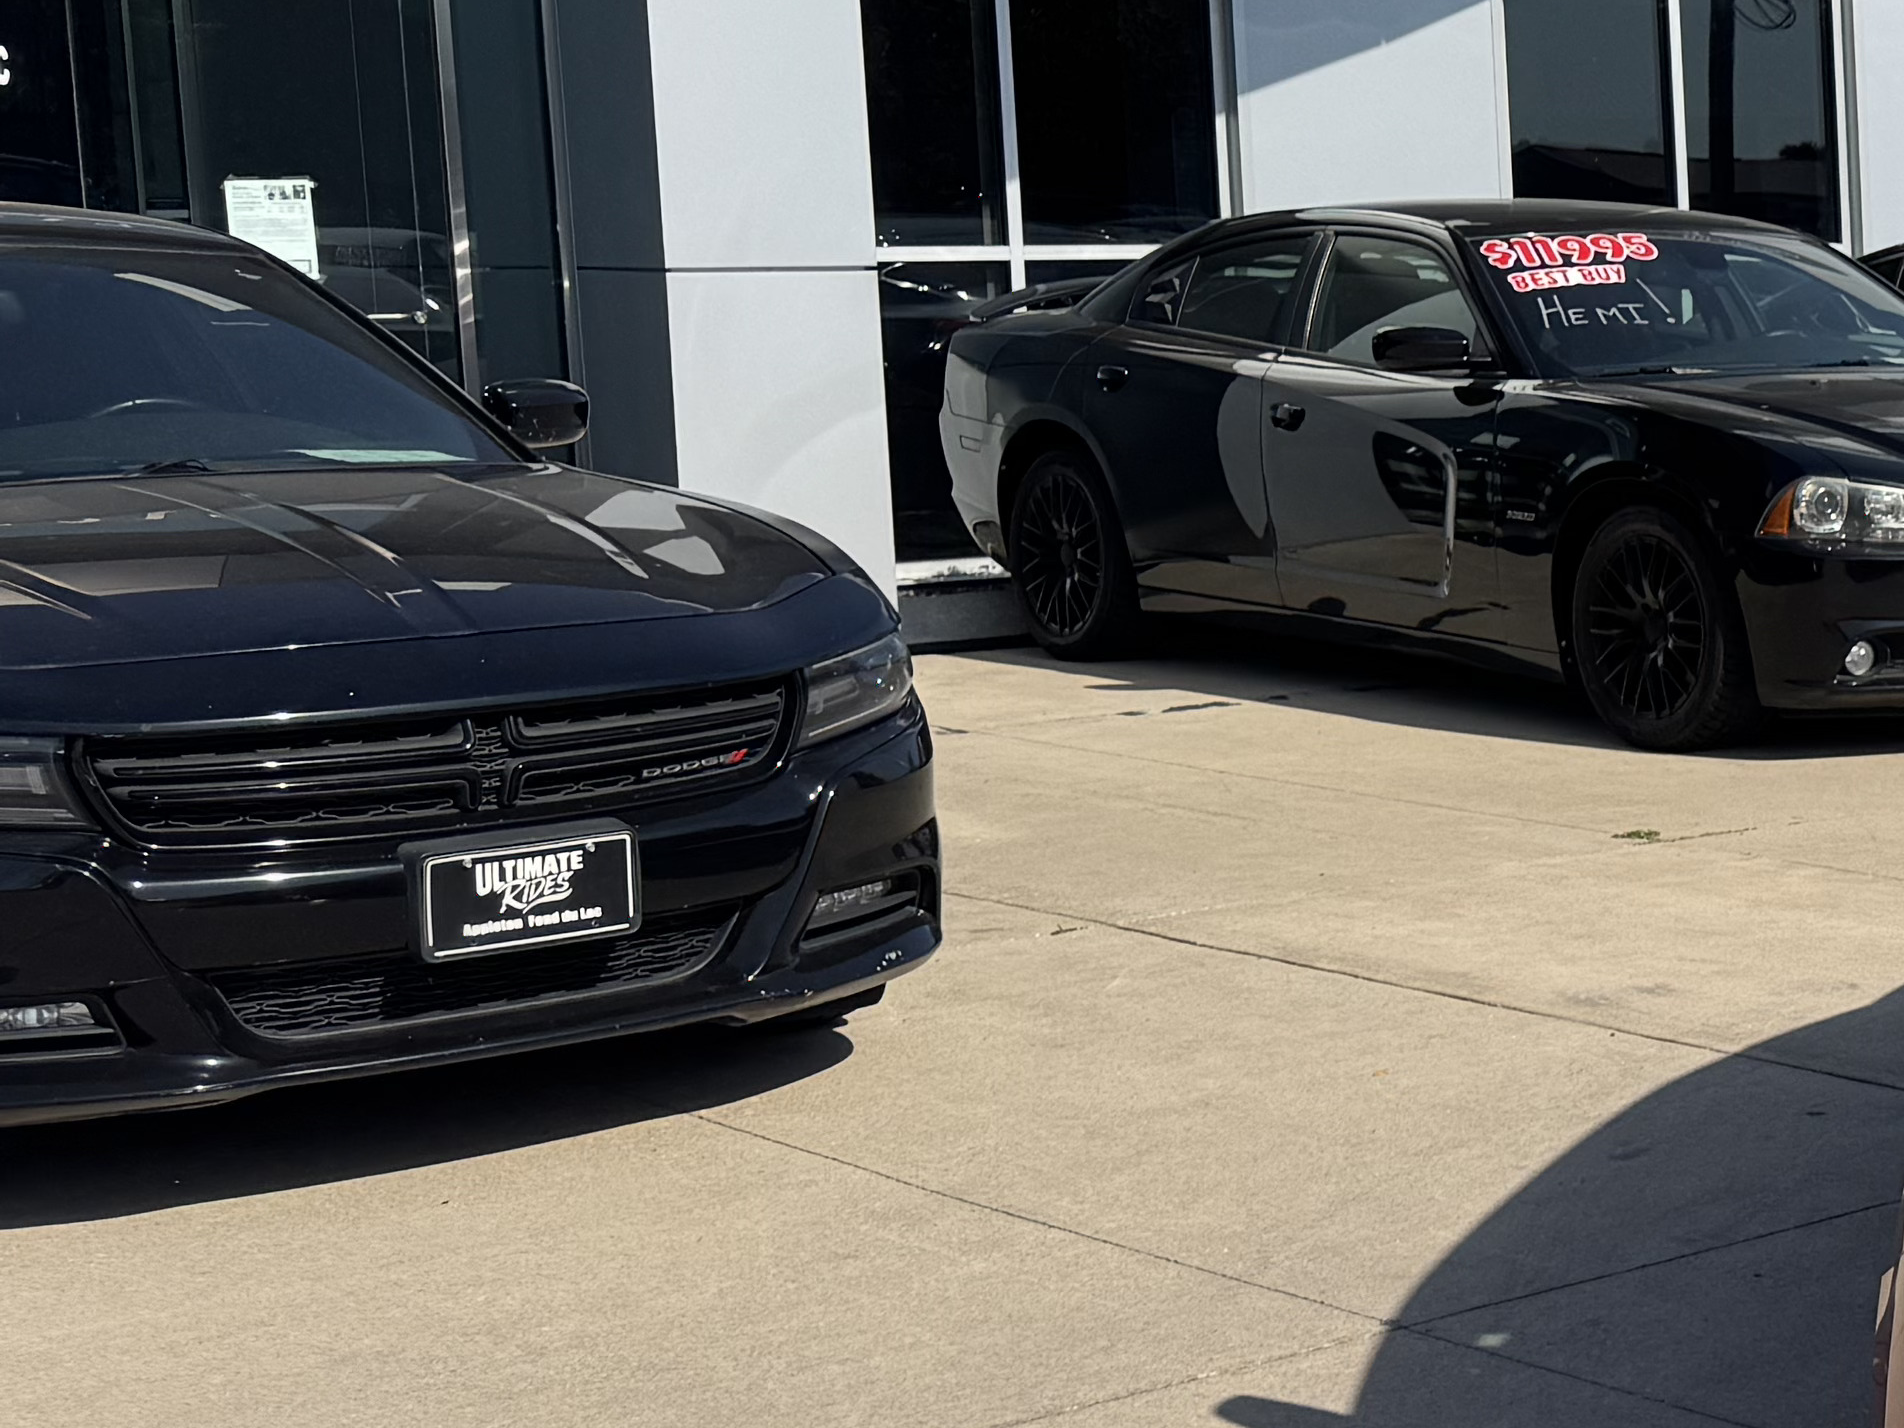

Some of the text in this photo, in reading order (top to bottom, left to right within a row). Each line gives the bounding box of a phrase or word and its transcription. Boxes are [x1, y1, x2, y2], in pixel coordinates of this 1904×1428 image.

[1480, 233, 1659, 269] $11995
[1510, 265, 1626, 291] BEST BUY
[475, 850, 584, 897] ULTIMATE
[462, 918, 525, 937] Appleton
